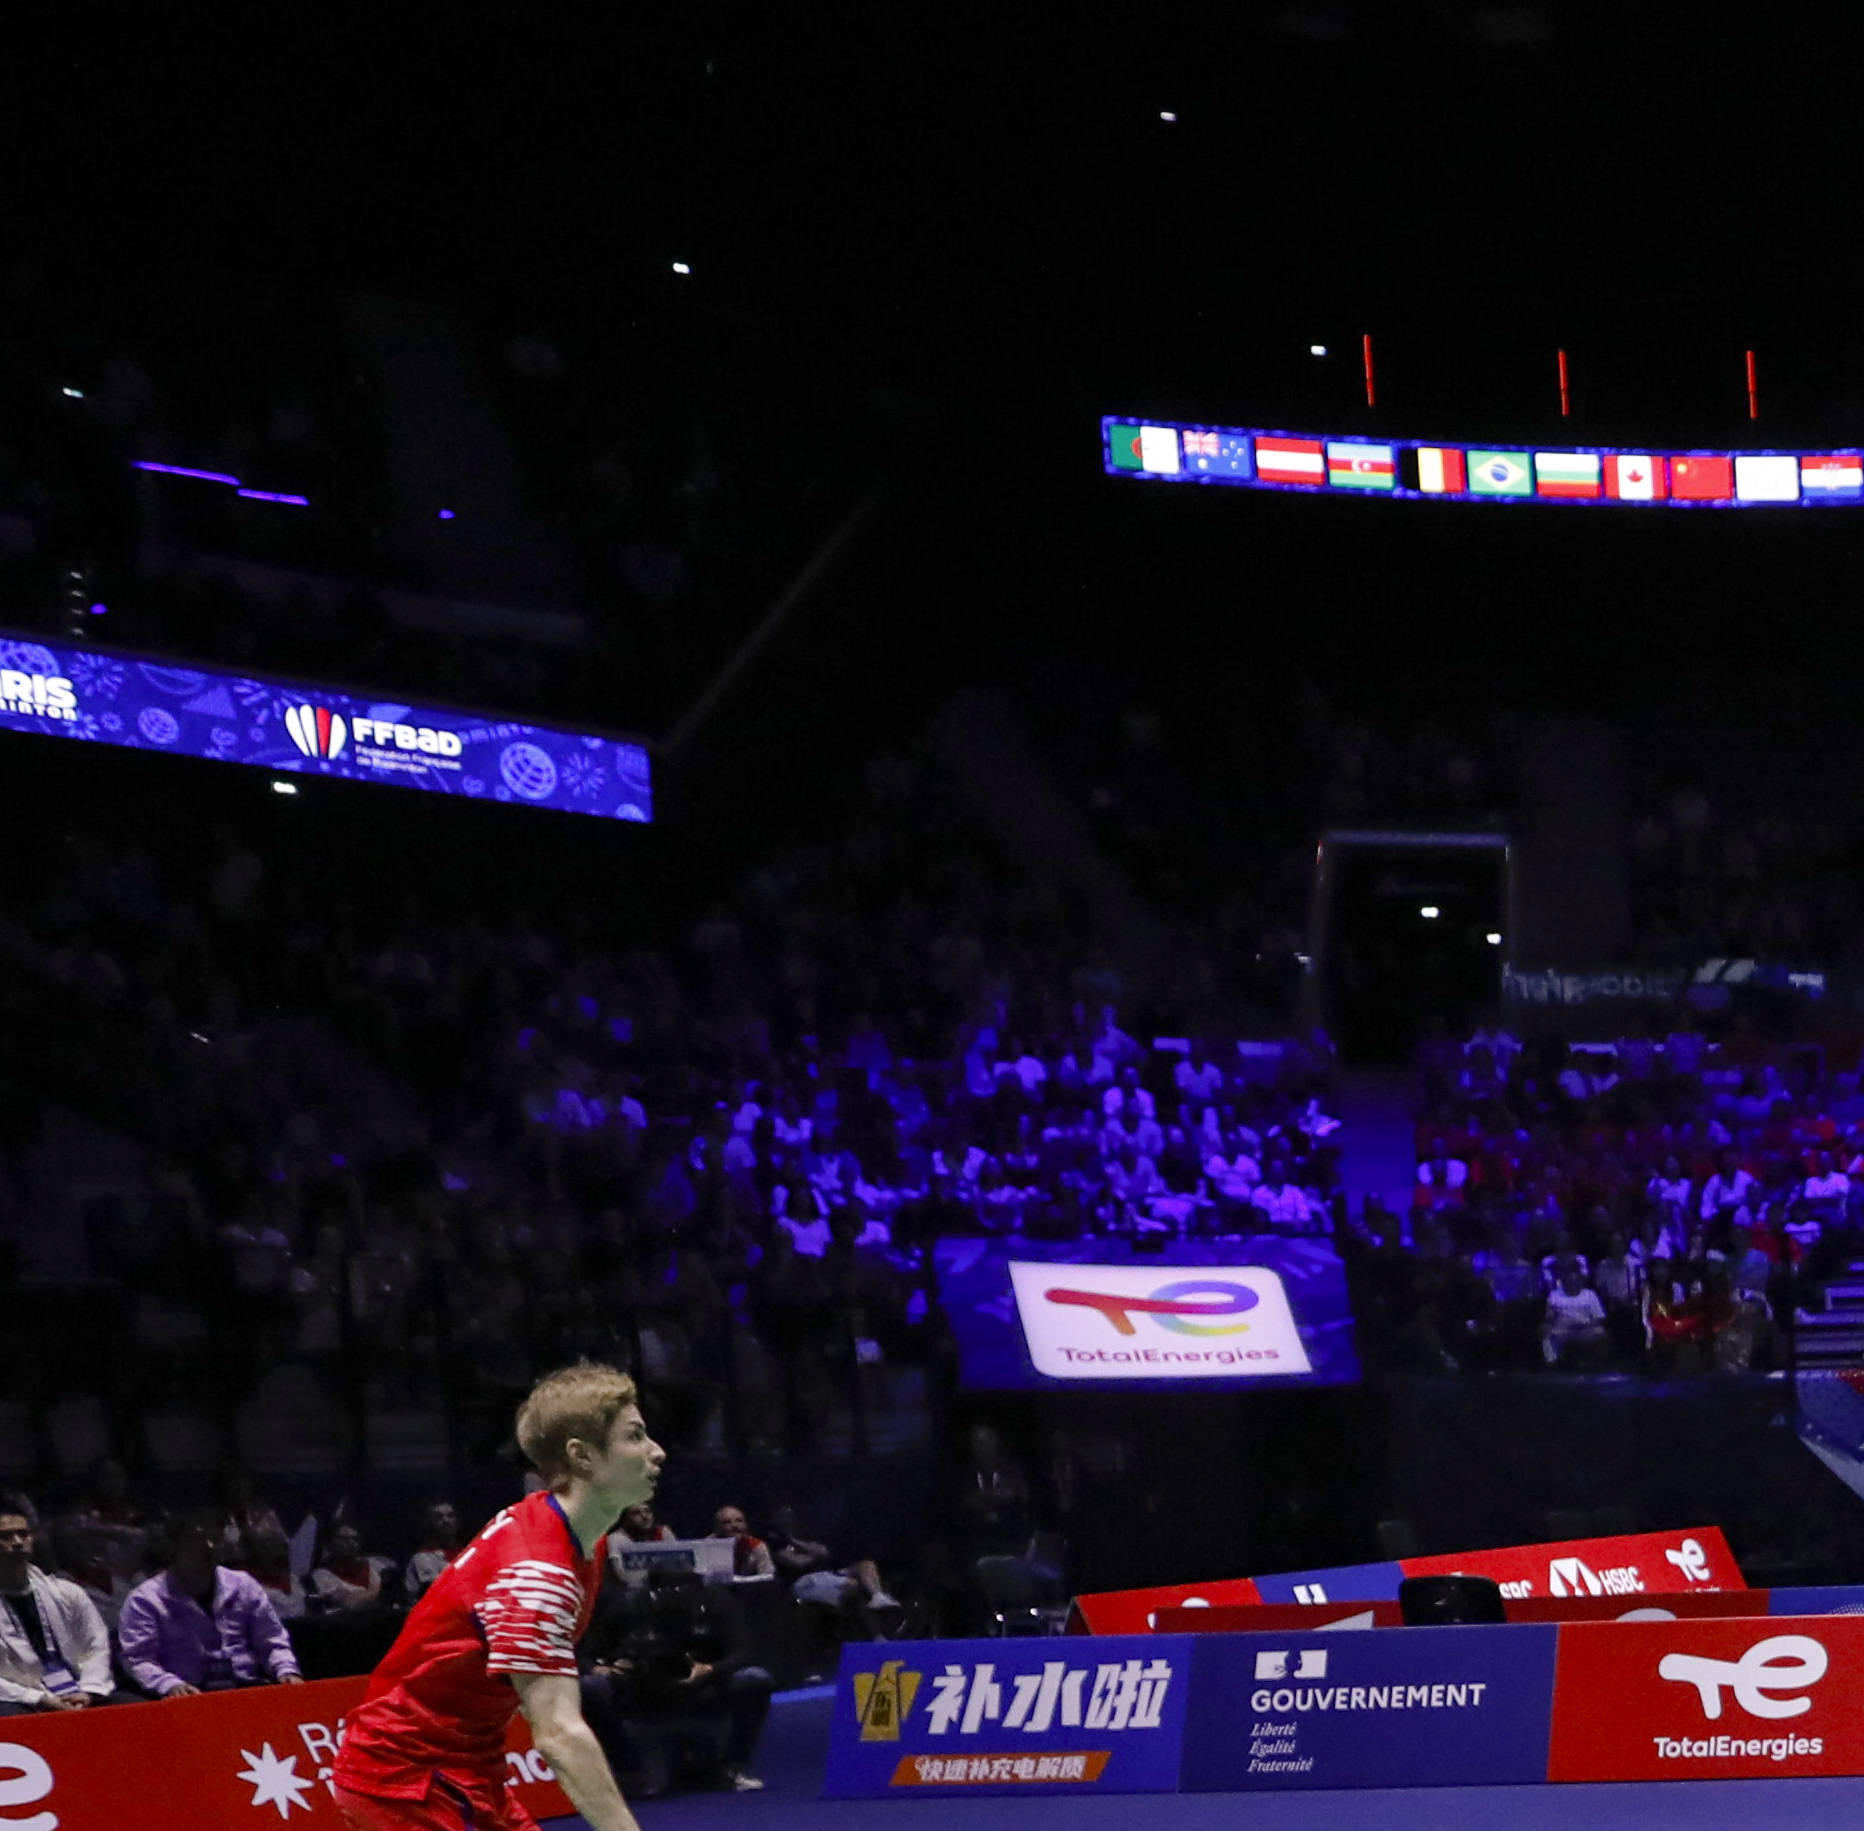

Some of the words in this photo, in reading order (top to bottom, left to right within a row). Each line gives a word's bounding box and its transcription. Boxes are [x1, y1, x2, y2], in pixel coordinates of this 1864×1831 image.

[0, 669, 78, 709] RIS
[1057, 1347, 1280, 1364] TotalEnergies
[1499, 1580, 1533, 1599] SBC
[1598, 1566, 1646, 1596] HSBC
[925, 1659, 1173, 1735] 补水啦
[1251, 1683, 1487, 1713] GOUVERNEMENT
[1250, 1721, 1298, 1737] Liberté
[1249, 1737, 1296, 1757] Égalité
[1653, 1733, 1823, 1761] TotalEnergies
[1247, 1757, 1314, 1773] Fraternité
